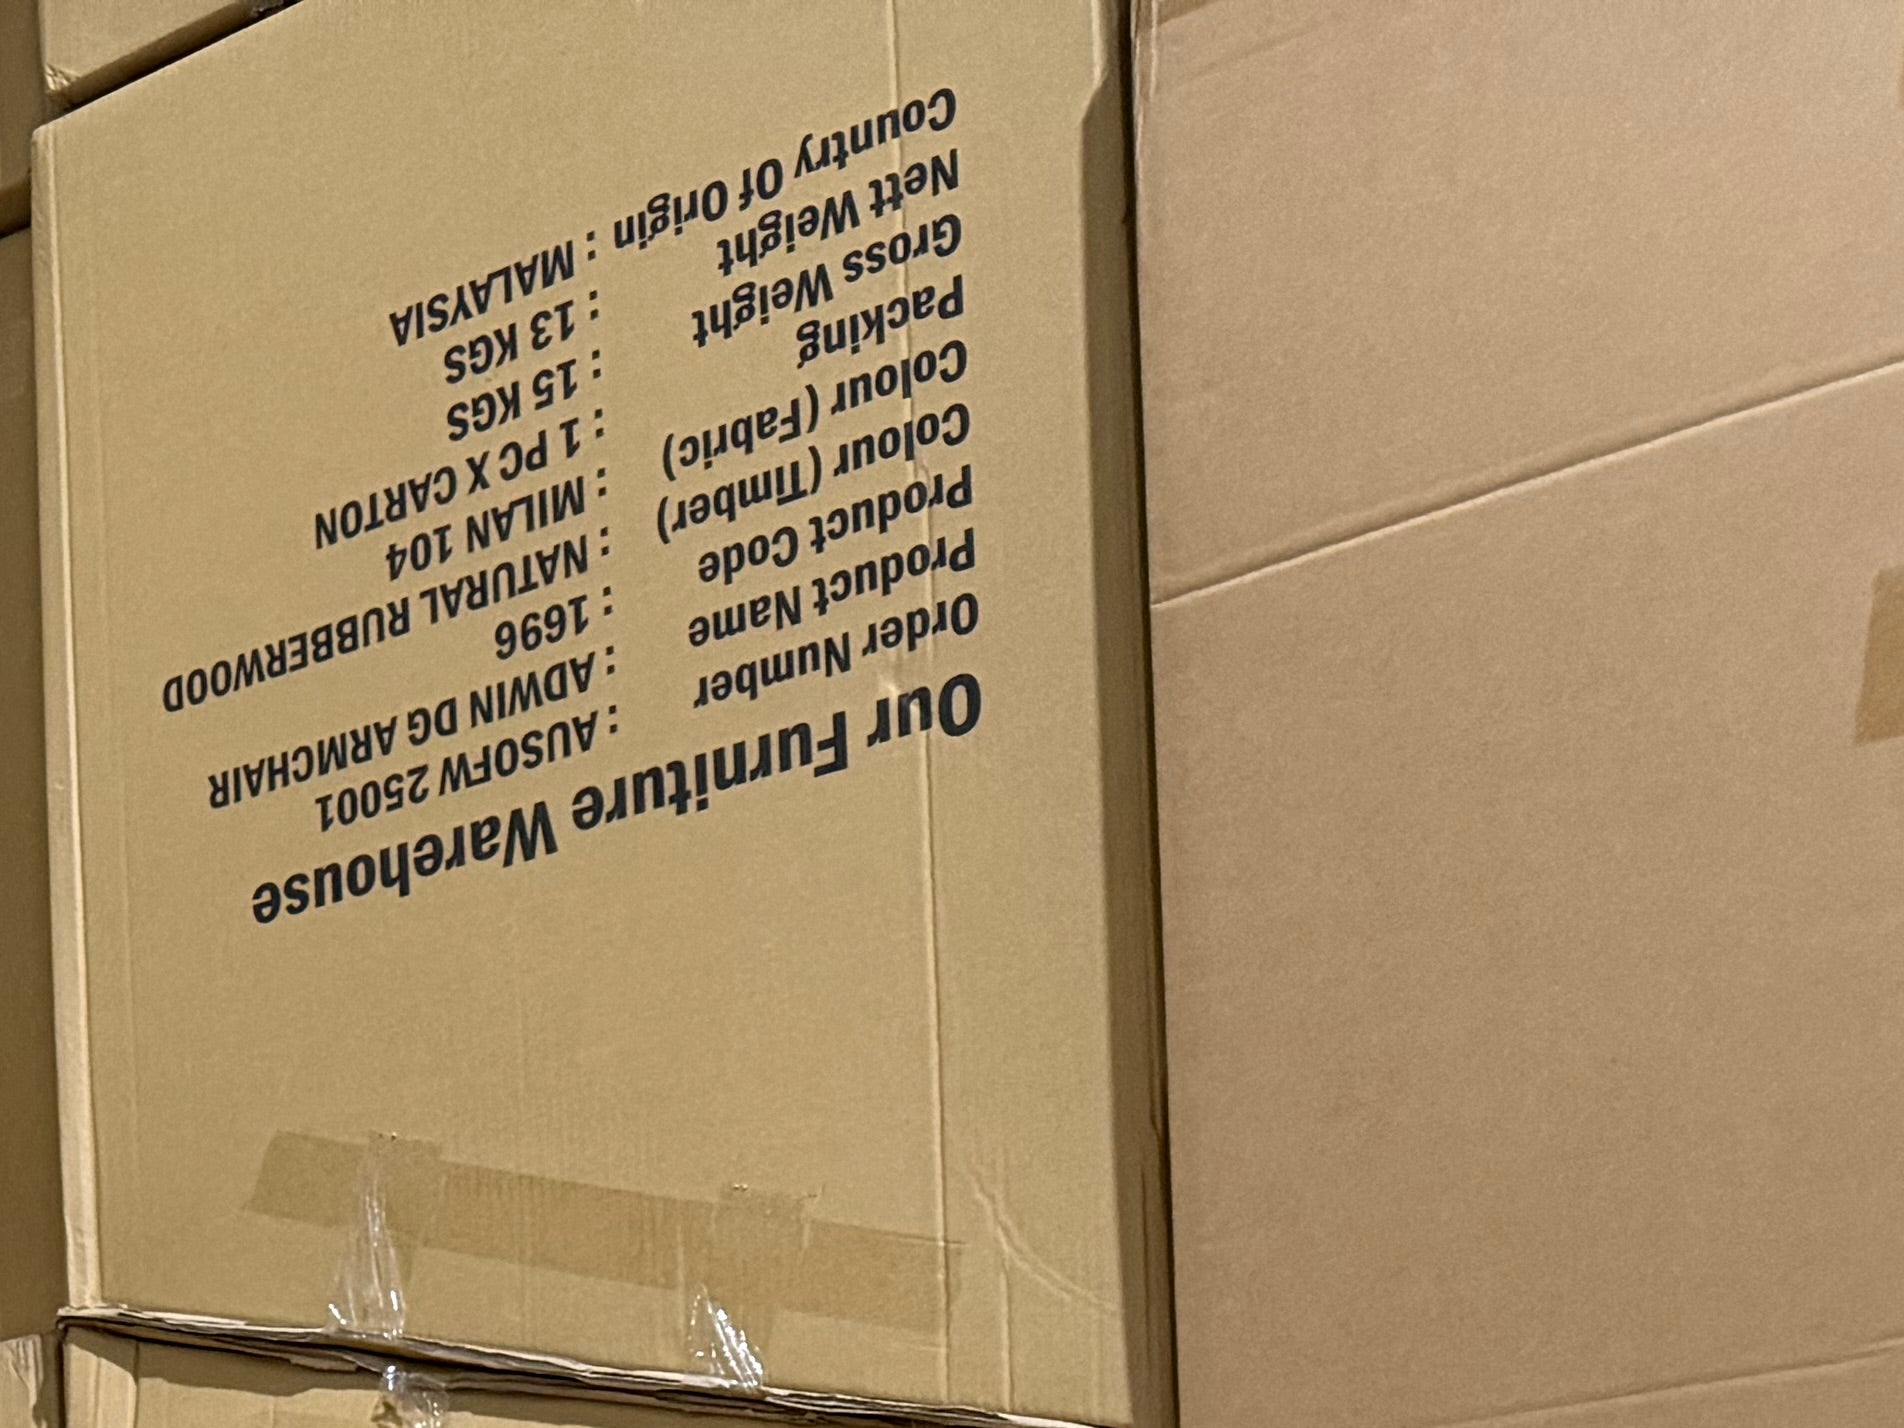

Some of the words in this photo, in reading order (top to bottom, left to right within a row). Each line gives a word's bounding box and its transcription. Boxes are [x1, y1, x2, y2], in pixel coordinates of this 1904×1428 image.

[867, 147, 959, 229] Nett
[716, 189, 861, 278] Weight
[443, 322, 519, 385] KGS
[529, 299, 575, 351] 13
[830, 339, 968, 416] Colour
[662, 383, 820, 483] (Fabric)
[466, 475, 585, 554] MILAN
[808, 463, 973, 555] Product
[385, 523, 453, 582] 104
[698, 525, 799, 586] Code
[811, 526, 976, 617] Product
[494, 593, 589, 661] 1696
[688, 584, 802, 648] Name
[861, 592, 979, 658] Order
[469, 650, 596, 729] ADWIN
[693, 631, 852, 709] Number
[407, 696, 458, 747] DG
[866, 672, 982, 748] Our
[207, 715, 398, 810] ARMCHAIR
[438, 709, 599, 797] AUSOFW
[571, 710, 849, 831] Furniture
[314, 763, 430, 833] 25001
[251, 800, 559, 924] Warehouse
